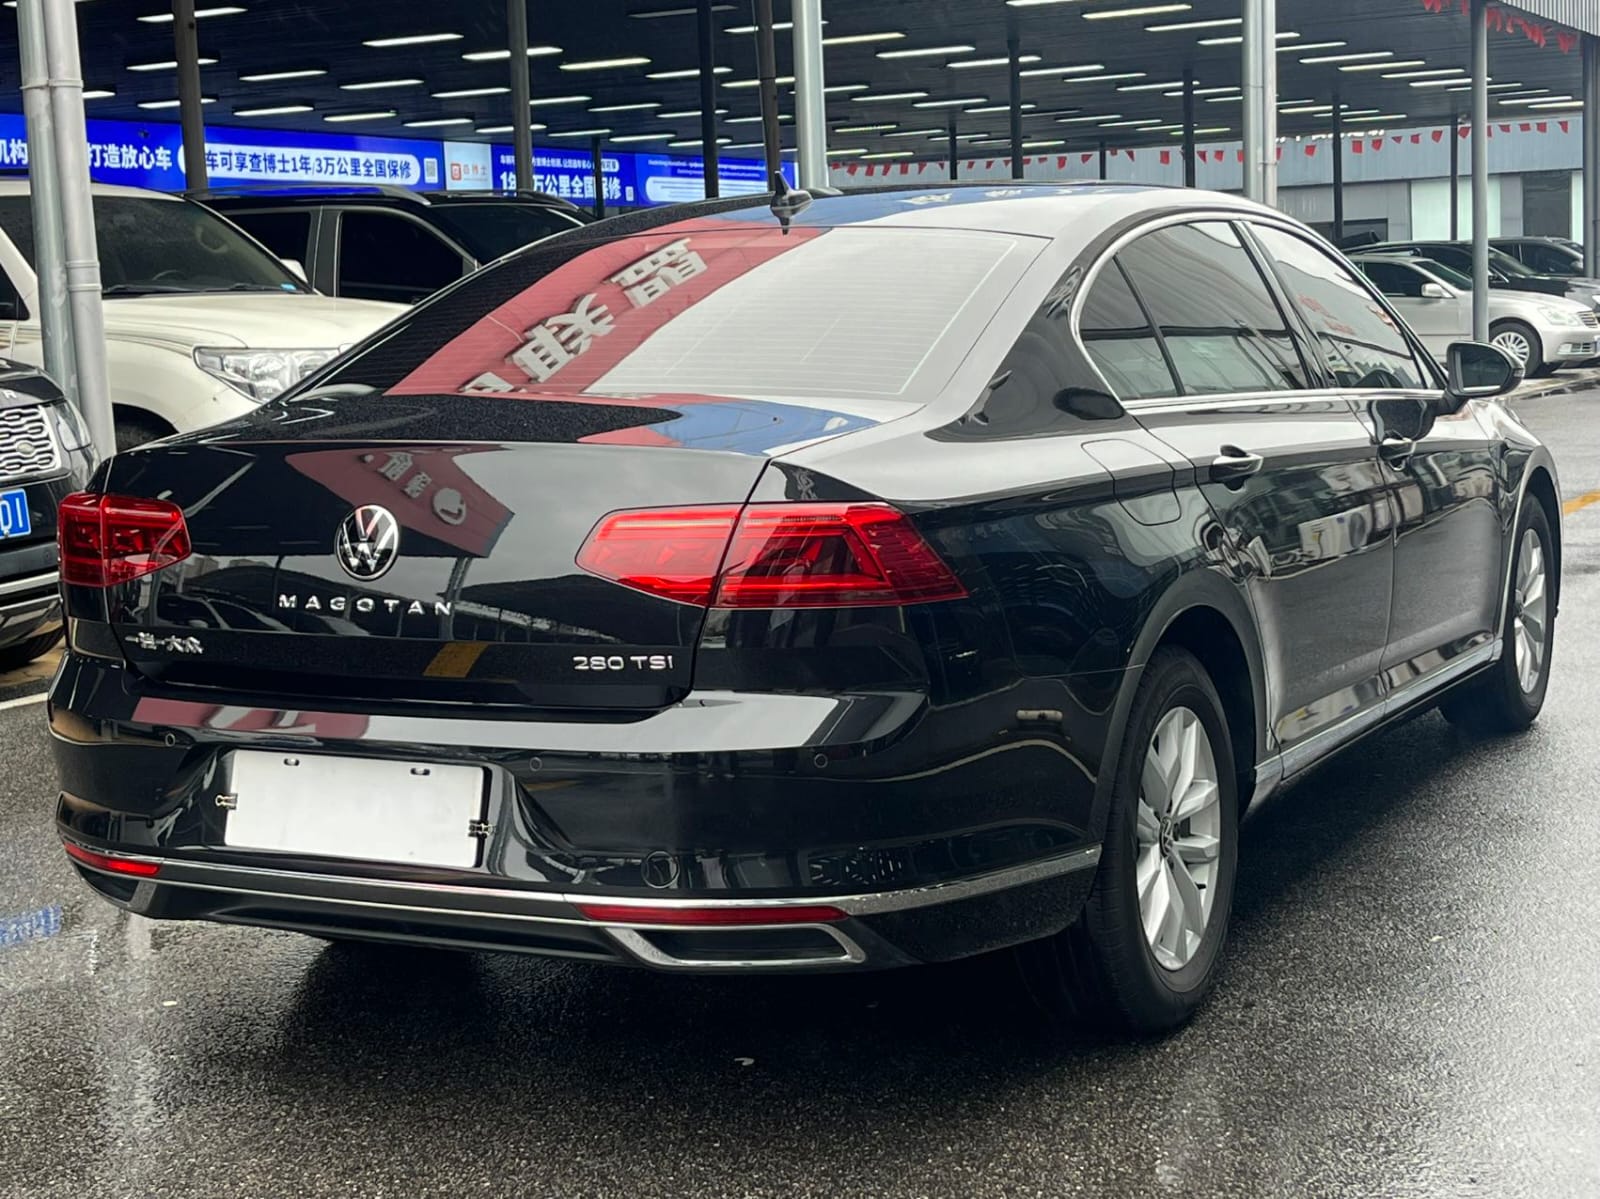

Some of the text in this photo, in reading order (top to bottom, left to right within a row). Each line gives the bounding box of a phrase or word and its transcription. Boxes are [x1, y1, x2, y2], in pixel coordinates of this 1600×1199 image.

[278, 593, 452, 616] MAGOTAN
[572, 654, 674, 670] 280 TSI
